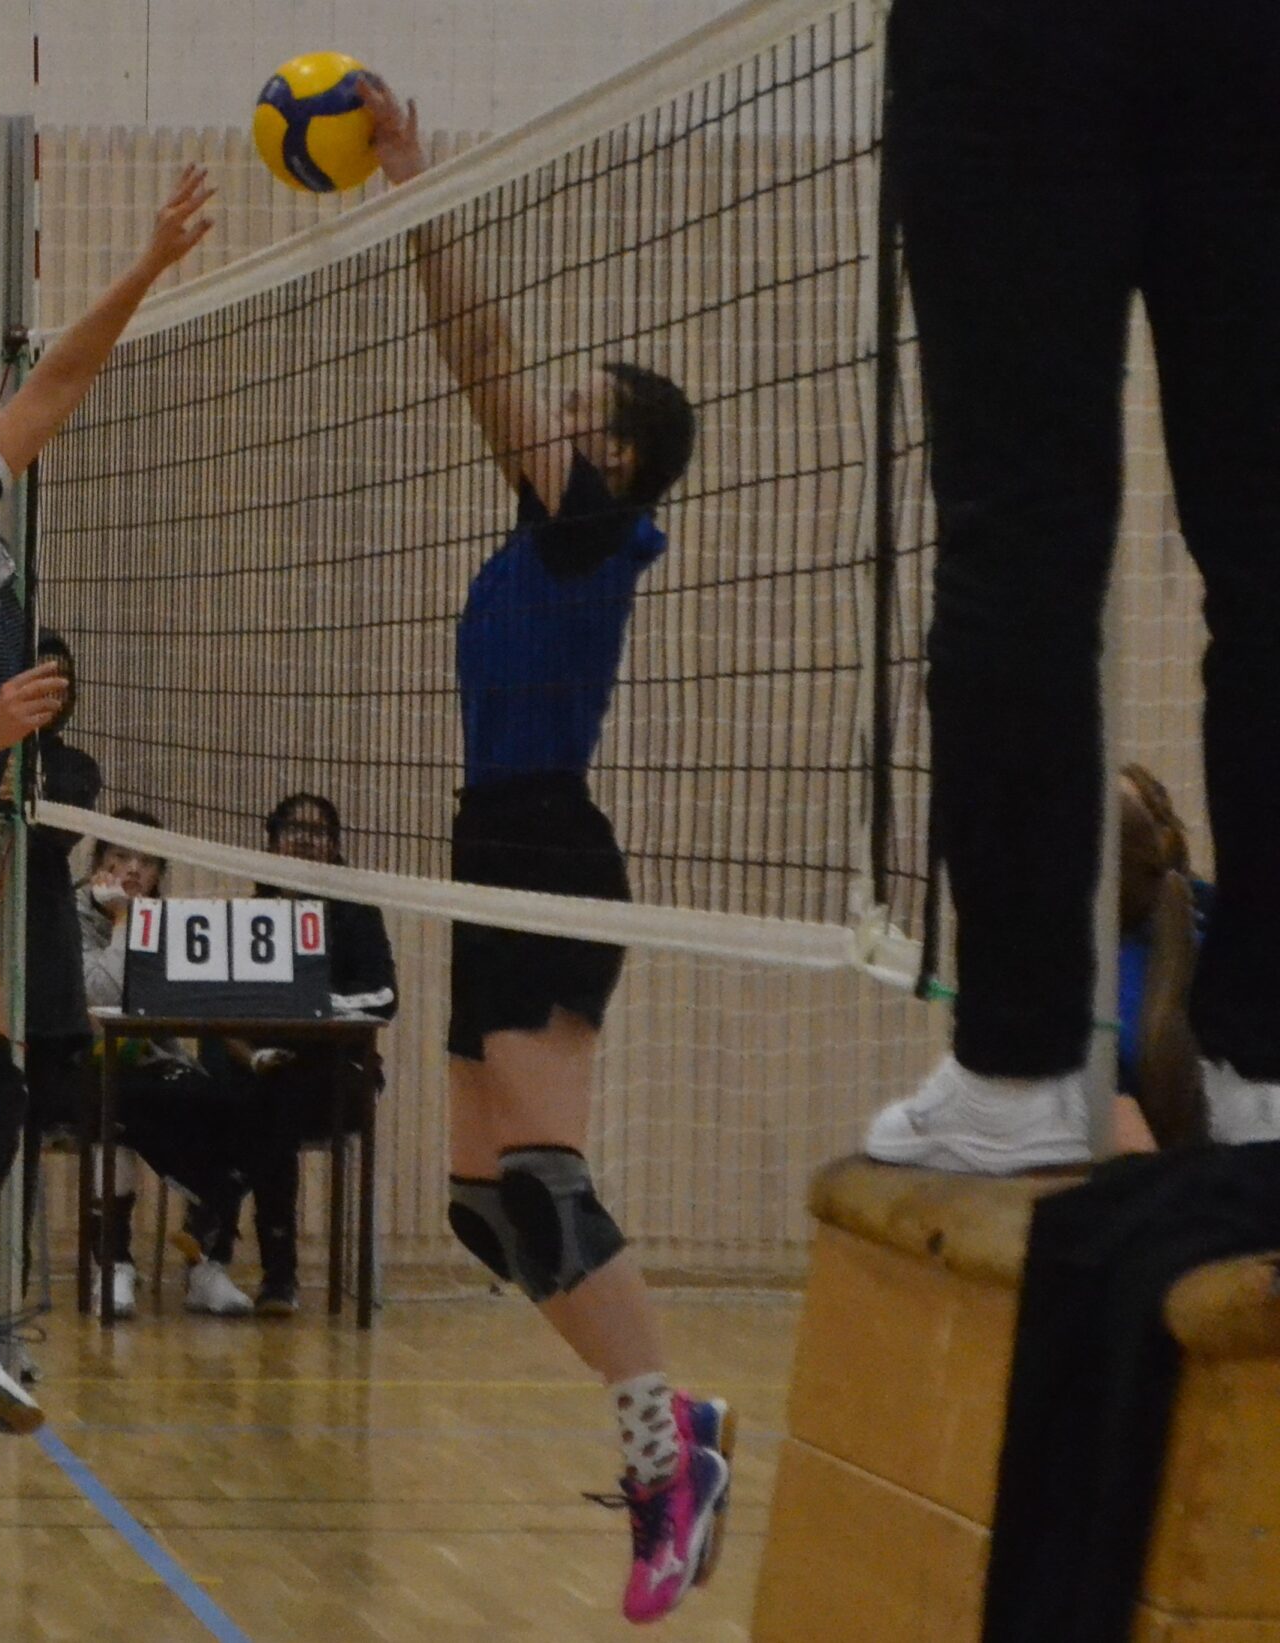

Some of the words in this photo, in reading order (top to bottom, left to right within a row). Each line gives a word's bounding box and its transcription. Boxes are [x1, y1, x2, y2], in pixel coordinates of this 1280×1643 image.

[139, 909, 153, 948] 1
[185, 915, 210, 964] 6
[250, 915, 275, 964] 8
[300, 912, 320, 950] 0
